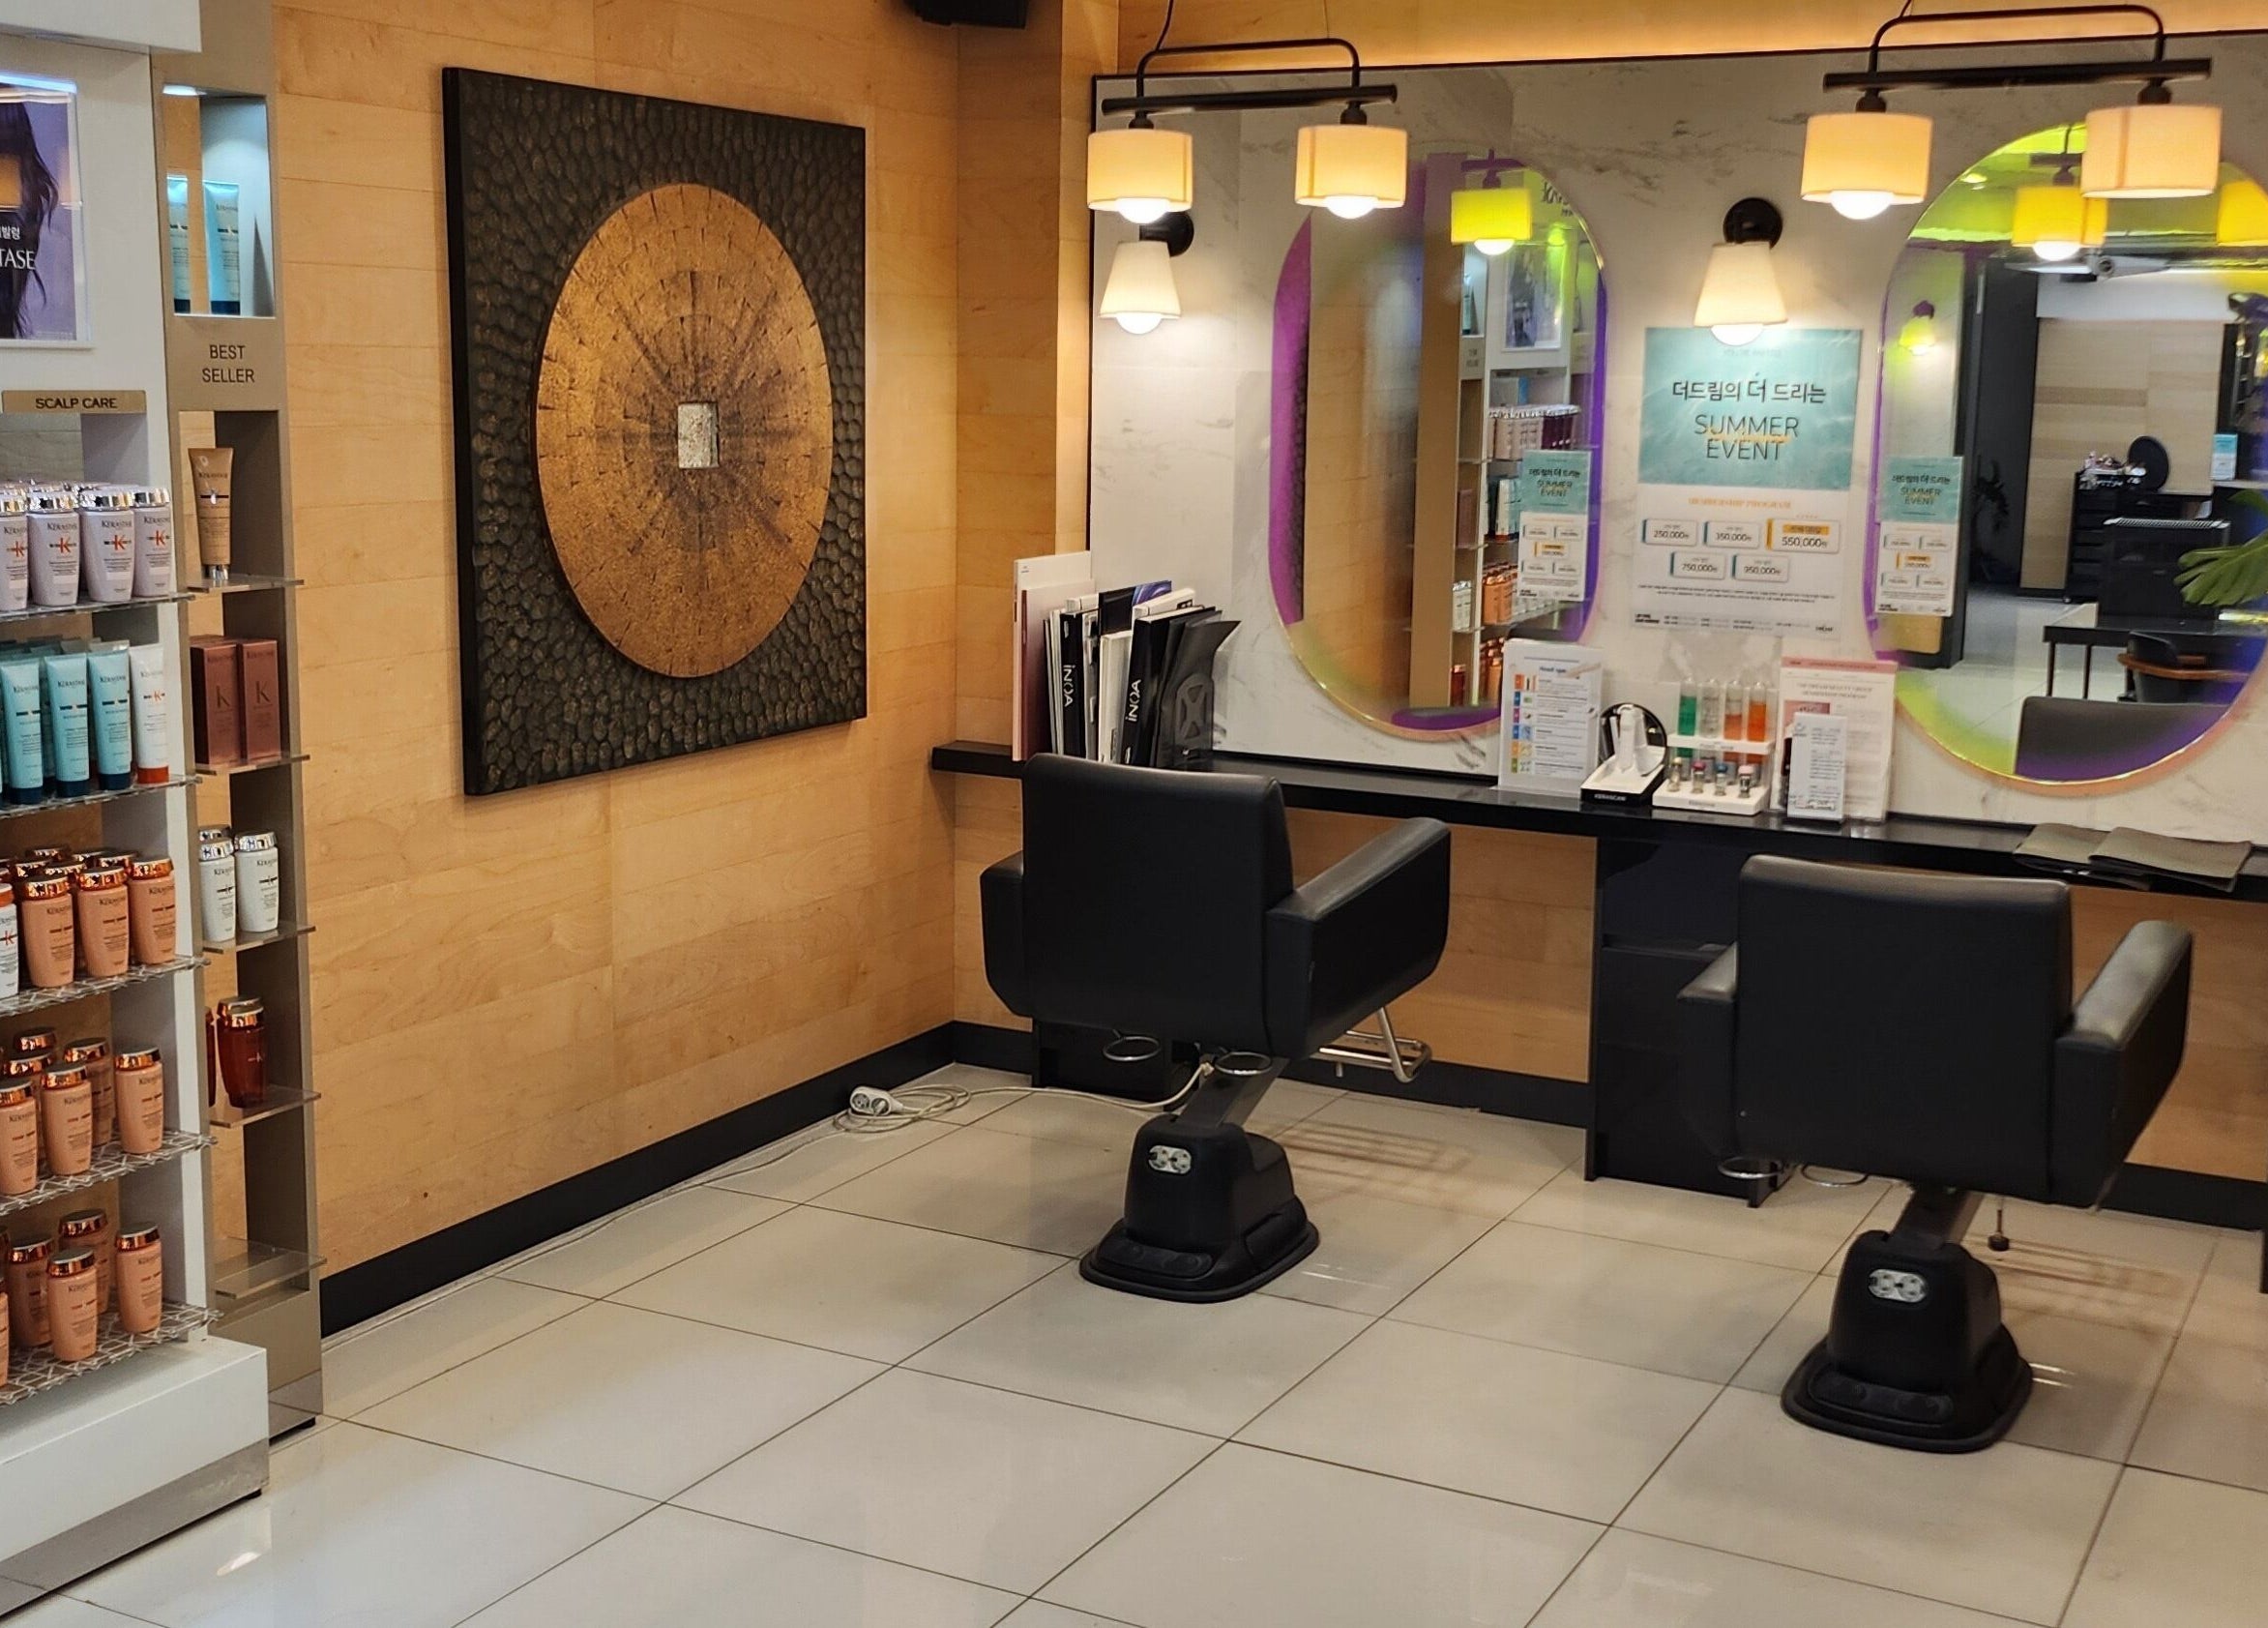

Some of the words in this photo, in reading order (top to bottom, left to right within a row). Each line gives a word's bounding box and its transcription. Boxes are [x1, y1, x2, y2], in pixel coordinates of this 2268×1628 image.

[209, 344, 246, 360] BEST
[201, 368, 255, 383] SELLER
[1672, 380, 1741, 401] 더드림의
[1747, 378, 1767, 402] 더
[1771, 382, 1827, 404] 드리는
[35, 398, 79, 409] SCALP
[82, 398, 118, 409] CARE
[1694, 414, 1800, 437] SUMMER
[1706, 437, 1782, 460] EVENT
